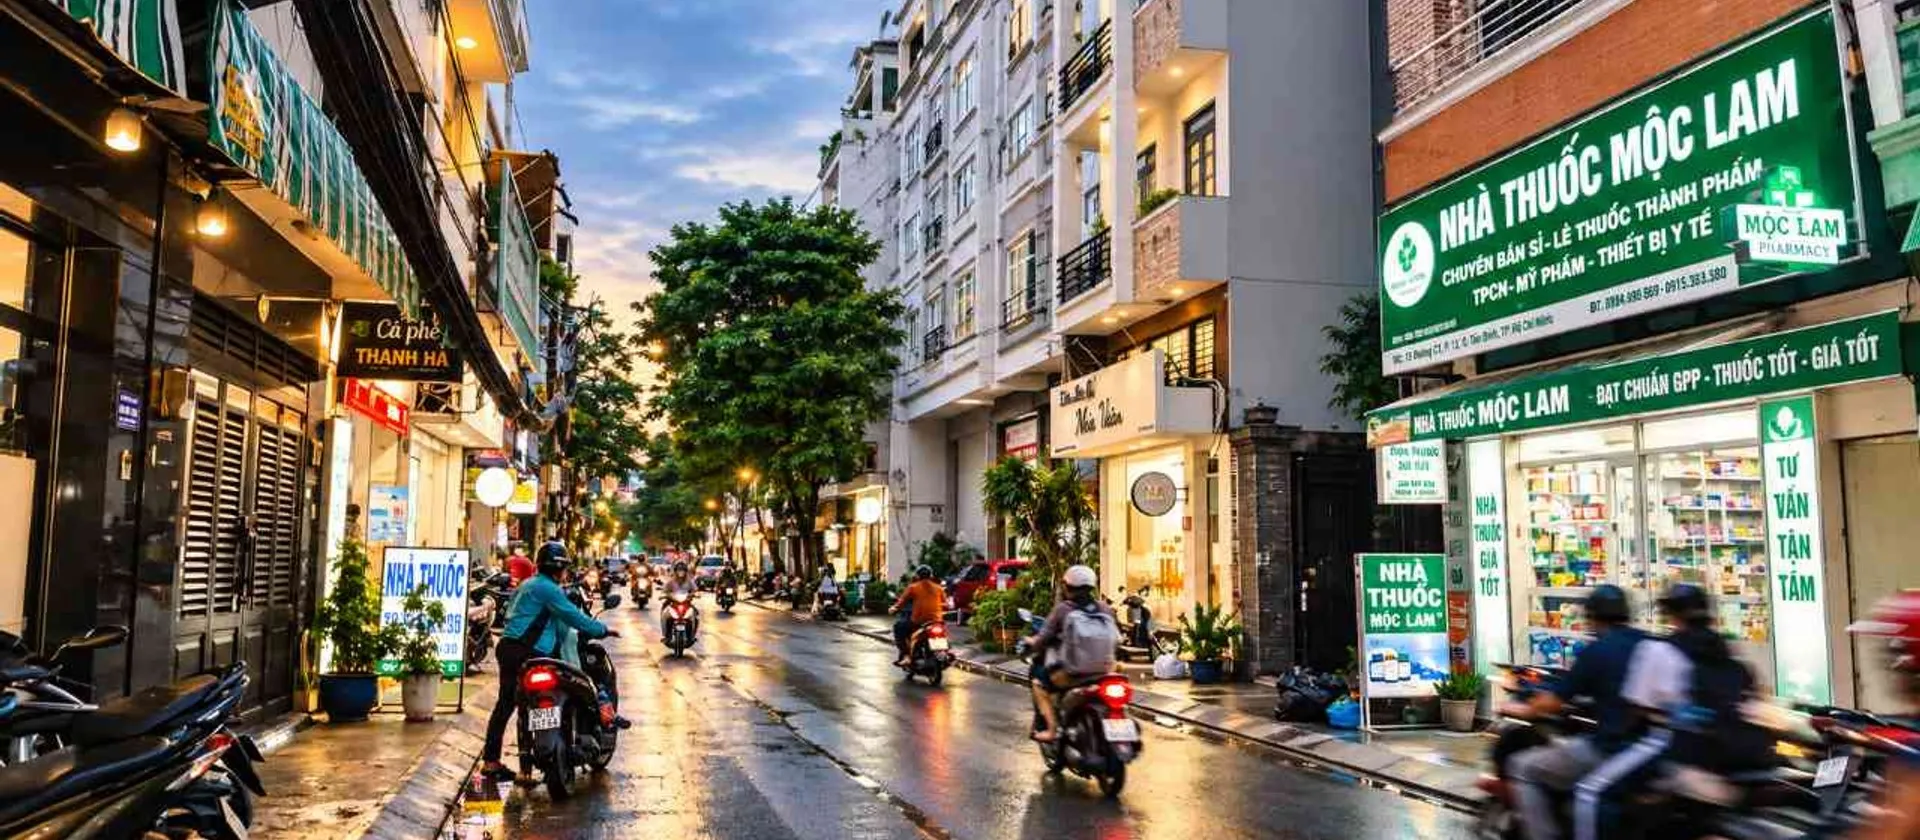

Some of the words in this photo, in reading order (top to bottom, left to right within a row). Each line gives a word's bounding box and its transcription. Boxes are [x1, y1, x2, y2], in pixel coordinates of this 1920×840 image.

[1439, 183, 1496, 253] NHÀ
[1500, 131, 1603, 228] THUỐC
[1610, 105, 1694, 186] MỘC
[1703, 58, 1800, 150] LAM
[1574, 201, 1632, 242] THUỐC
[1634, 187, 1698, 221] THÀNH
[1744, 210, 1790, 240] MỘC
[1797, 217, 1840, 240] LAM
[1596, 231, 1645, 268] THIẾT
[1648, 228, 1668, 255] BỊ
[1670, 222, 1684, 245] Y
[1687, 206, 1714, 240] TẾ
[1759, 241, 1831, 258] PHARMACY
[355, 347, 418, 365] THANH
[1673, 367, 1702, 393] GPP
[1712, 348, 1764, 387] THUỐC
[1767, 343, 1798, 378] TỐT
[1811, 336, 1842, 371] GIÁ
[1845, 326, 1880, 366] TỐT
[1414, 408, 1436, 435] NHÀ
[1437, 401, 1475, 431] THUỐC
[1477, 390, 1520, 429] MỘC
[1524, 384, 1570, 419] LAM
[1776, 451, 1801, 479] TƯ
[1773, 484, 1810, 520] VẤN
[1777, 528, 1812, 566] TẬN
[420, 552, 465, 598] THUỐC
[1380, 557, 1429, 583] NHÀ
[1366, 582, 1442, 608] THUỐC
[1369, 610, 1401, 631] MỘC
